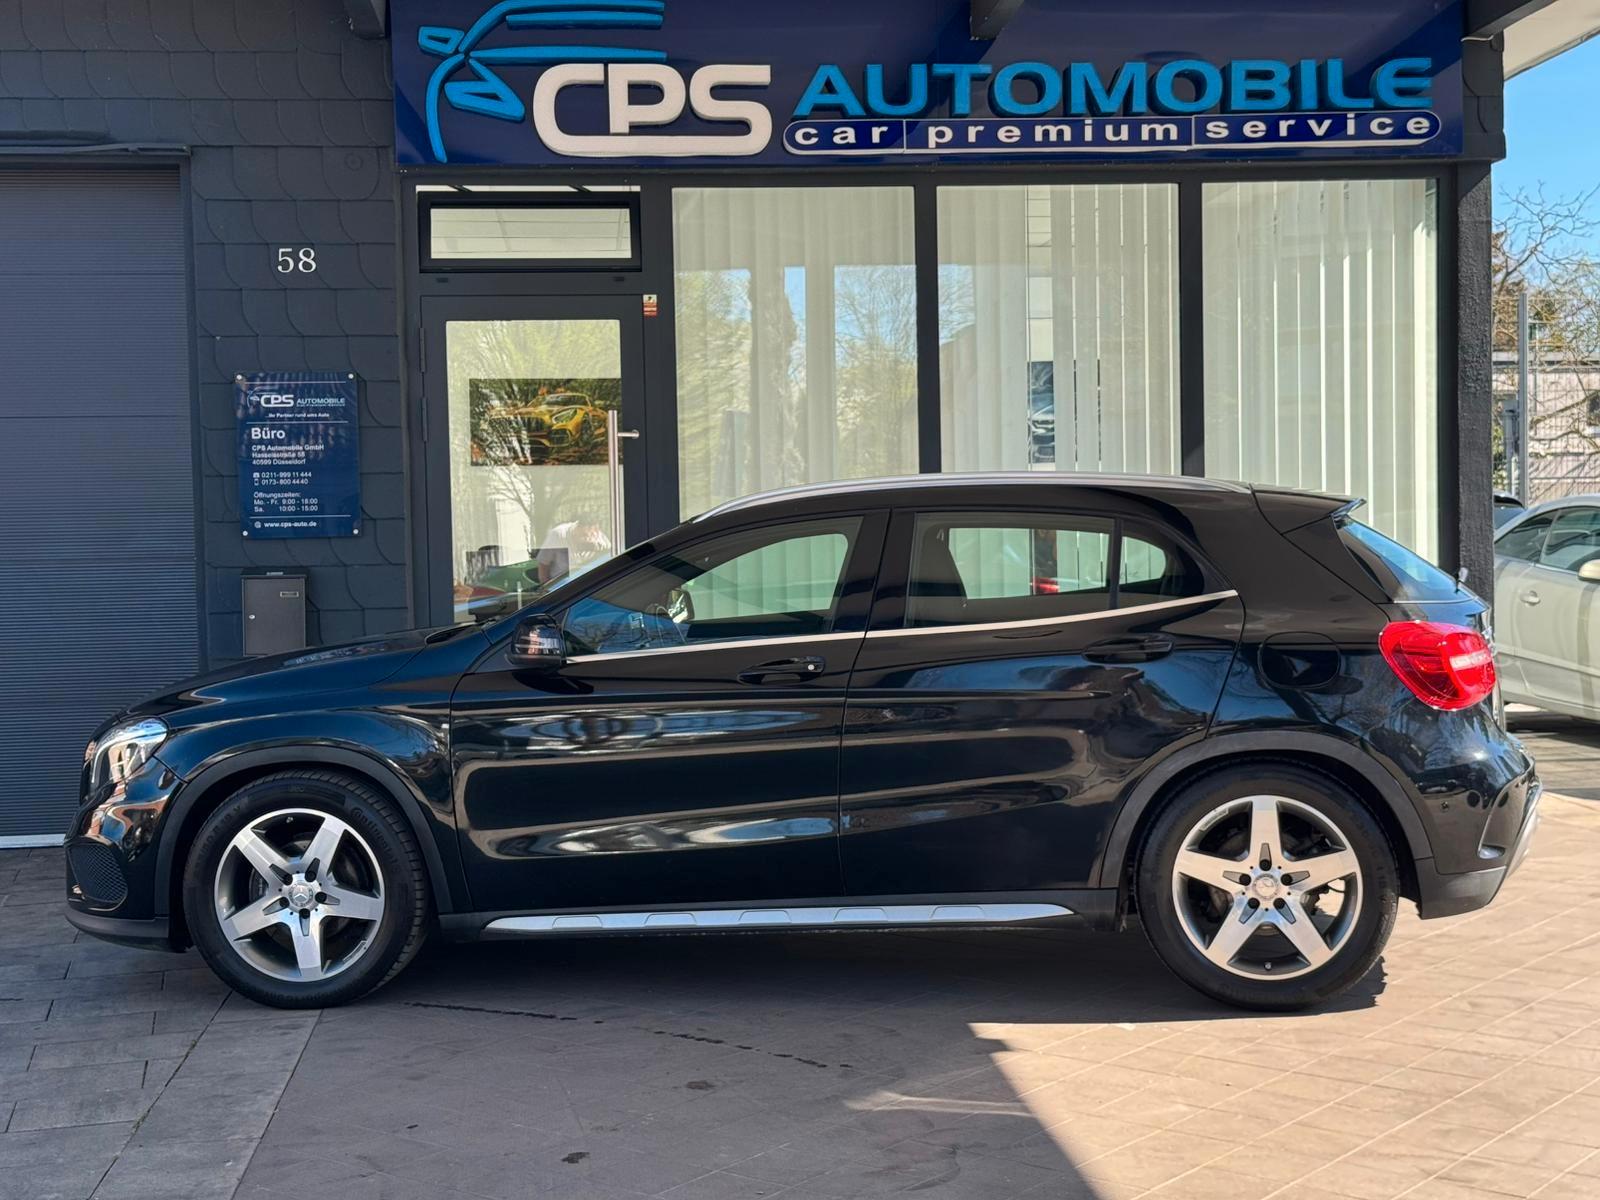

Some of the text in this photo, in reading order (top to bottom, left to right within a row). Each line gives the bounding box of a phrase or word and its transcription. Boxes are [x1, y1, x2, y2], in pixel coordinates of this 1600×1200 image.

[532, 57, 1433, 157] CPS AUTOMOBILE
[794, 112, 1432, 149] car premium service
[277, 247, 317, 273] 58
[260, 394, 295, 408] CPS
[251, 427, 286, 440] Büro
